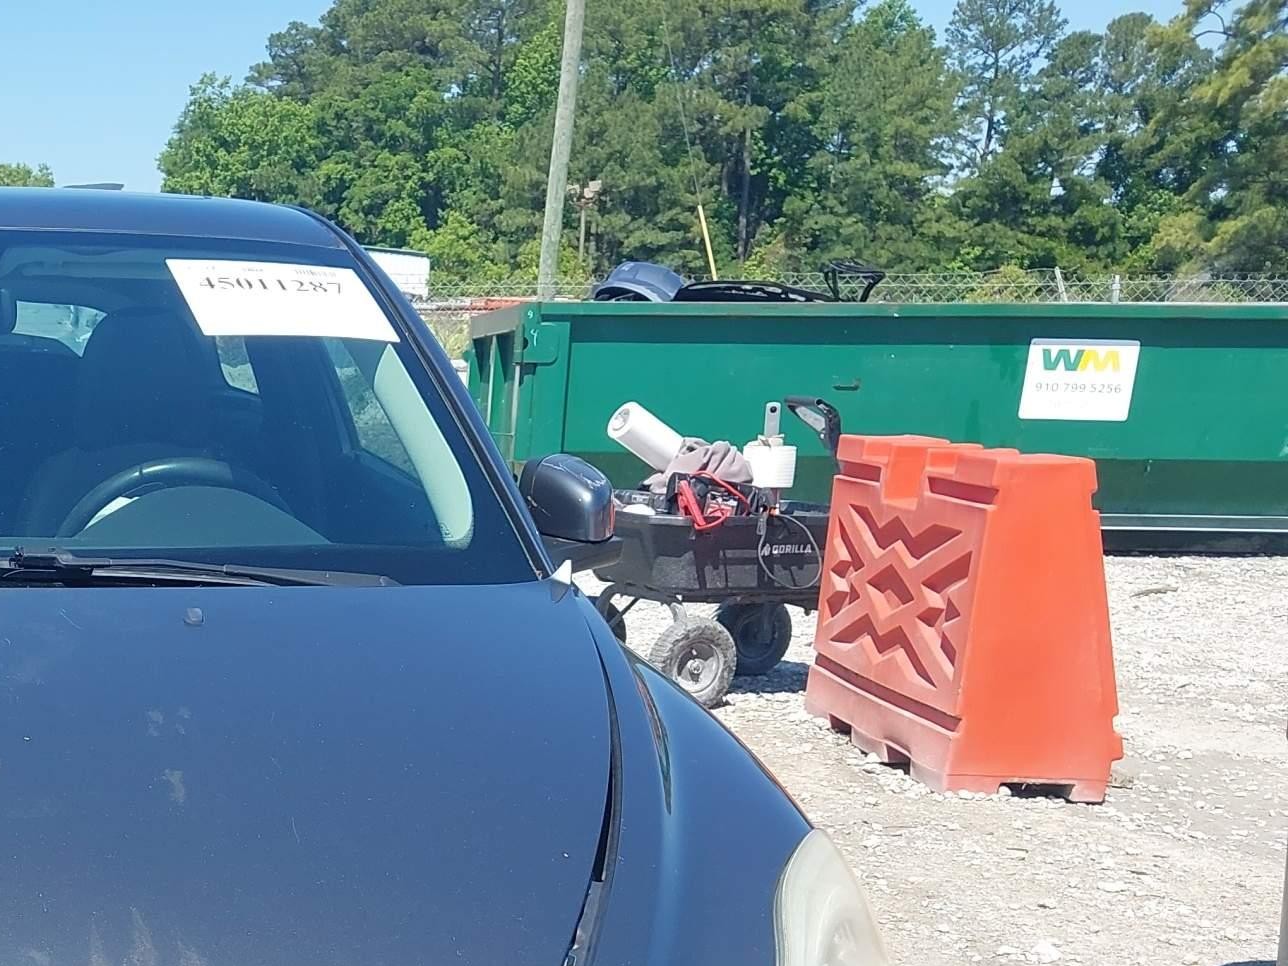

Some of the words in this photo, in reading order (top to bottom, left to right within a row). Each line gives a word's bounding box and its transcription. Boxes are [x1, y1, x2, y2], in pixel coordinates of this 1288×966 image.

[199, 276, 343, 295] 45011287
[1042, 348, 1121, 372] WM
[1035, 382, 1059, 392] 910
[1063, 383, 1086, 393] 799
[1089, 384, 1122, 394] 5256
[772, 544, 812, 554] GORILLA
